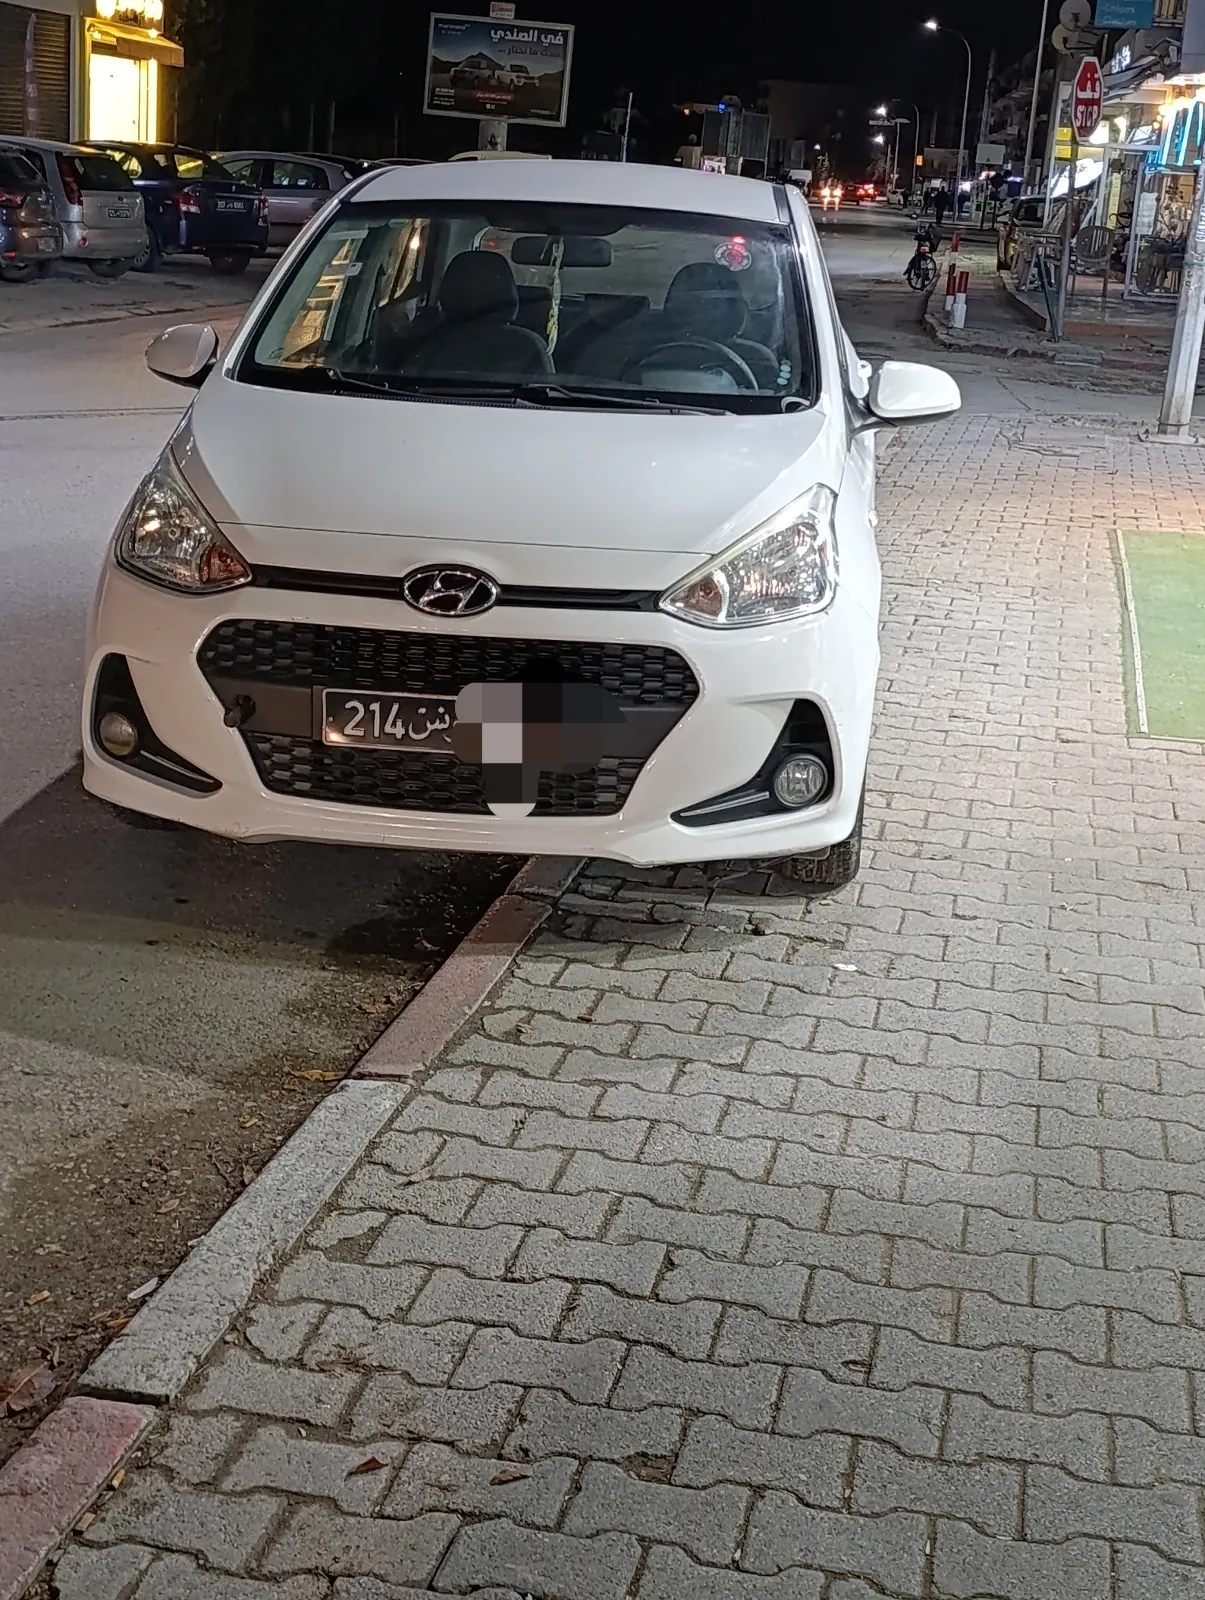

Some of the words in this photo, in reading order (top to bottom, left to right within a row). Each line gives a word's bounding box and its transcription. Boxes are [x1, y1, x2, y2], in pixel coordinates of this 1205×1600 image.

[540, 31, 564, 46] في
[1077, 72, 1100, 99] قف
[1075, 104, 1098, 127] STOP
[343, 700, 405, 739] 214
